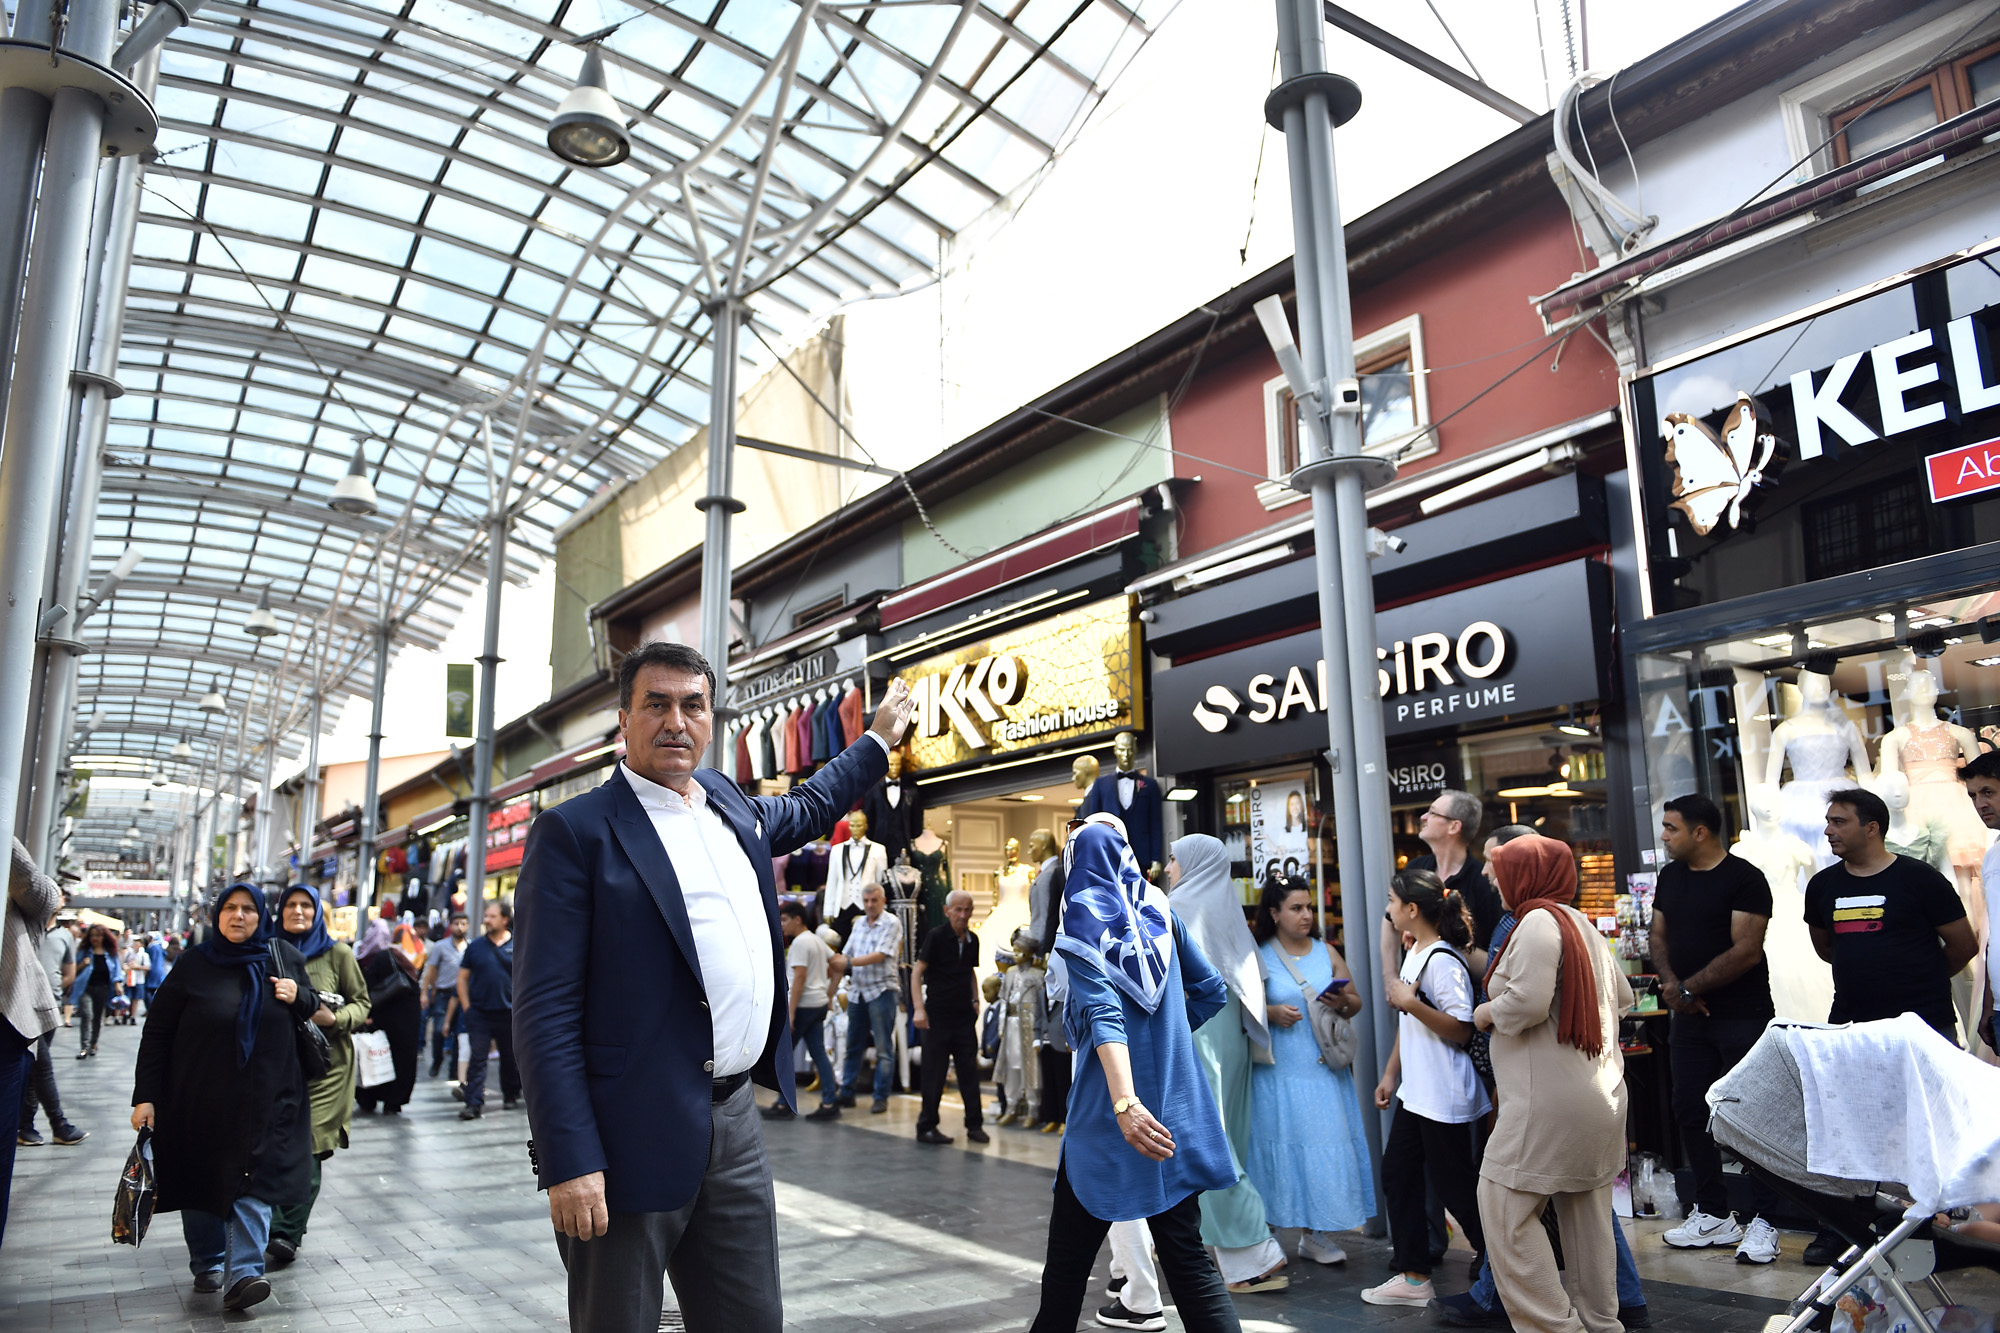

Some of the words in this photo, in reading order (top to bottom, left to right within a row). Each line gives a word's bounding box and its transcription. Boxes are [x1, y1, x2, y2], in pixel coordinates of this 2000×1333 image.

[1002, 714, 1060, 740] fashion
[1063, 699, 1118, 726] house
[1398, 683, 1516, 722] PERFUME
[1399, 780, 1446, 793] PERFUME
